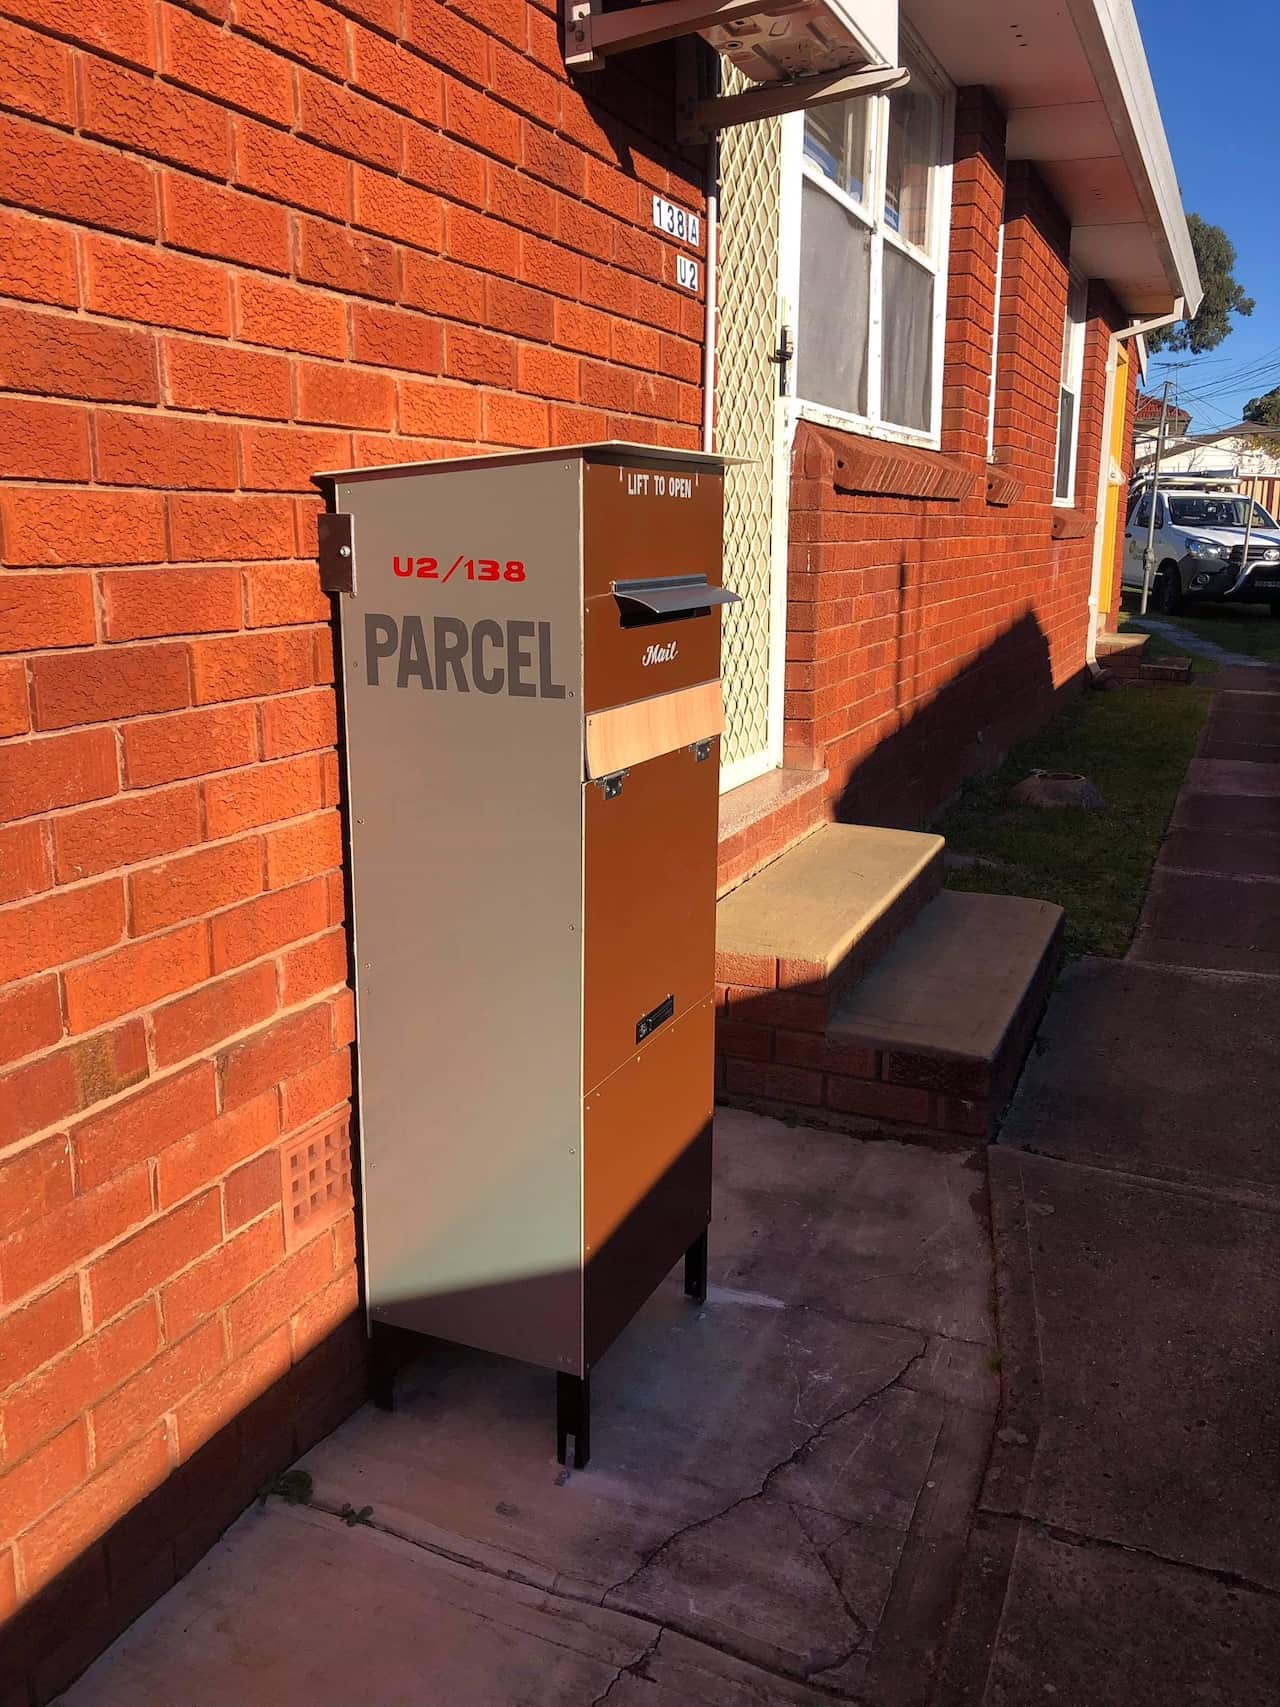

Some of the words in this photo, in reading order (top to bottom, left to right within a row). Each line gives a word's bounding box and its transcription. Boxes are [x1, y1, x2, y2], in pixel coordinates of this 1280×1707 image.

[678, 258, 697, 290] U2
[628, 473, 649, 496] LIFT
[654, 475, 666, 496] TO
[669, 477, 692, 499] OPEN
[392, 555, 527, 583] U2/138
[364, 613, 566, 699] PARCEL
[642, 641, 678, 666] Mail
